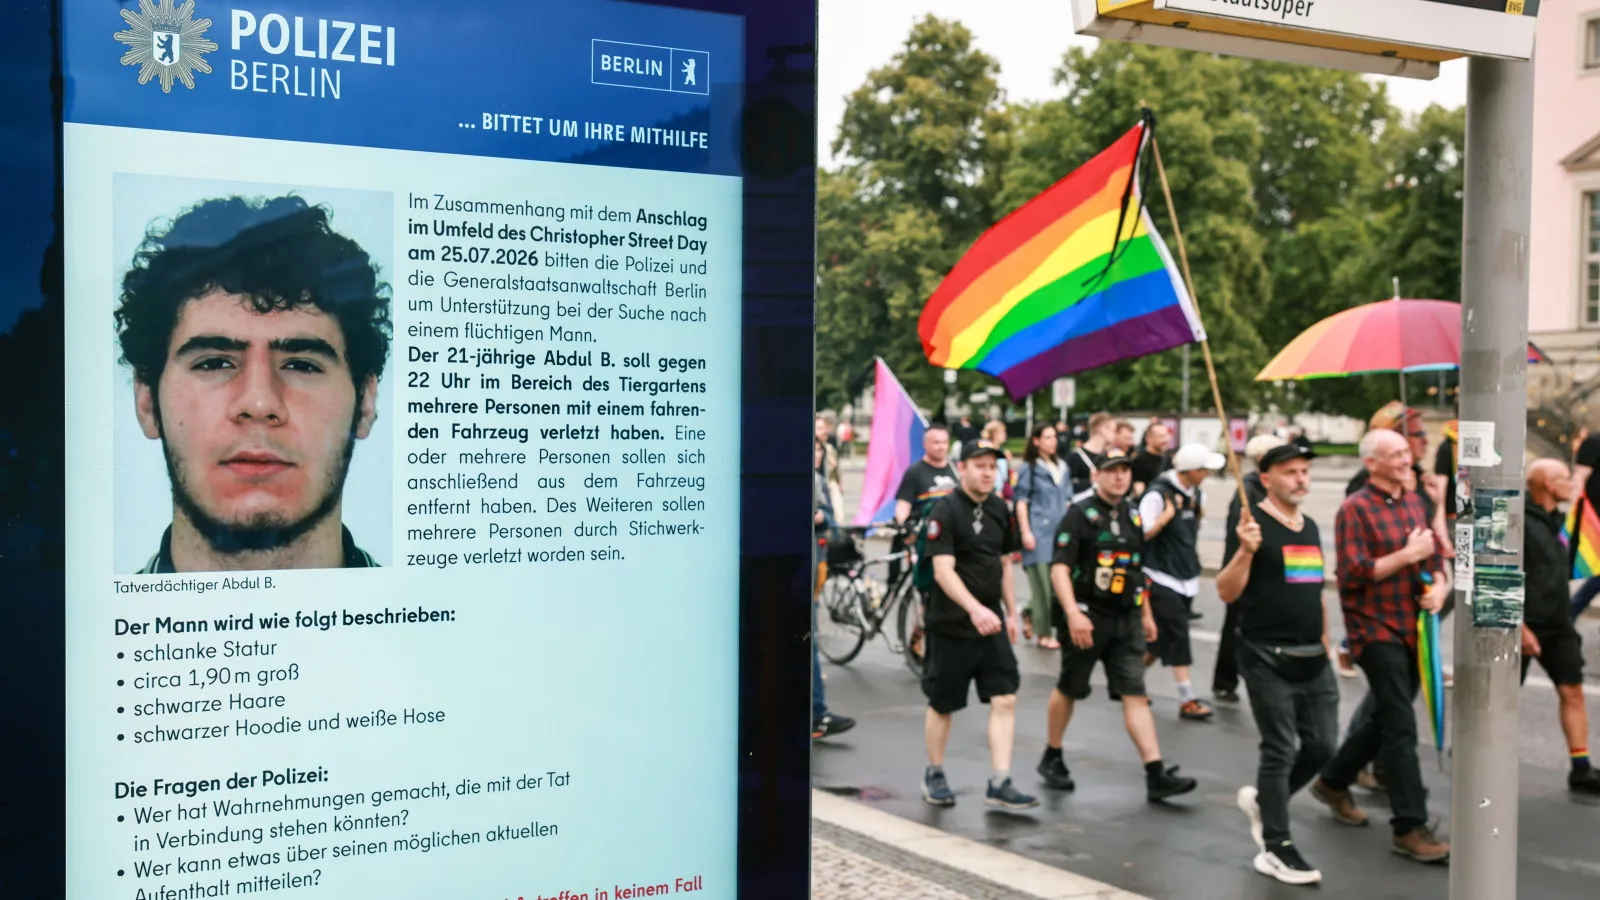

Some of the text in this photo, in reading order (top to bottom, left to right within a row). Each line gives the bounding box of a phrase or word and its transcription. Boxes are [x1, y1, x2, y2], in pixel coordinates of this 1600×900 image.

[1508, 2, 1522, 13] BVG
[232, 9, 395, 66] POLIZEI
[602, 55, 662, 76] BERLIN
[231, 59, 340, 99] BERLIN
[483, 113, 543, 134] BITTET
[550, 119, 577, 137] UM
[585, 122, 624, 141] IHRE
[631, 126, 707, 148] MITHILFE
[410, 193, 707, 231] Im Zusammenhang mit dem Anschlag
[409, 218, 707, 255] im Umfeld des Christopher Street Day
[408, 246, 706, 274] am 25.07.2026 bitten die Polizei und
[408, 270, 706, 298] die Generalstaatsanwaltschaft Berlin
[409, 297, 706, 322] um Unterstützung bei der Suche nach
[408, 322, 596, 344] einem flüchtigen Mann.
[409, 346, 705, 372] Der 21-jährige Abdul B. soll gegen
[408, 372, 706, 396] 22 Uhr im Bereich des Tiergartens
[408, 398, 705, 416] mehrere Personen mit einem fahren-
[408, 423, 705, 443] den Fahrzeug verletzt haben. Eine
[408, 448, 705, 464] oder mehrere Personen sollen sich
[408, 473, 704, 491] anschließend aus dem Fahrzeug
[408, 496, 704, 515] entfernt haben. Des Weiteren sollen
[408, 520, 704, 540] mehrere Personen durch Stichwerk-
[408, 546, 624, 569] zeuge verletzt worden sein.
[114, 577, 275, 593] Tatverdächtiger Abdul B.
[115, 607, 455, 635] Der Mann wird wie folgt beschrieben:
[134, 641, 277, 662] schlanke Statur
[134, 672, 180, 689] circa
[258, 663, 298, 686] groß
[134, 694, 285, 716] schwarze Haare
[135, 708, 445, 743] schwarzer Hoodie und weiße Hose
[116, 766, 328, 799] Die Fragen der Polizei:
[134, 772, 570, 824] Wer hat Wahrnehmungen gemacht, die mit der Tat
[135, 810, 408, 851] in Verbindung stehen könnten?
[134, 822, 557, 878] Wer kann etwas über seinen möglichen aktuellen
[136, 869, 321, 900] Aufenthalt mitteilen?
[596, 888, 607, 900] in
[615, 884, 668, 900] keinem
[676, 876, 702, 892] Fall
